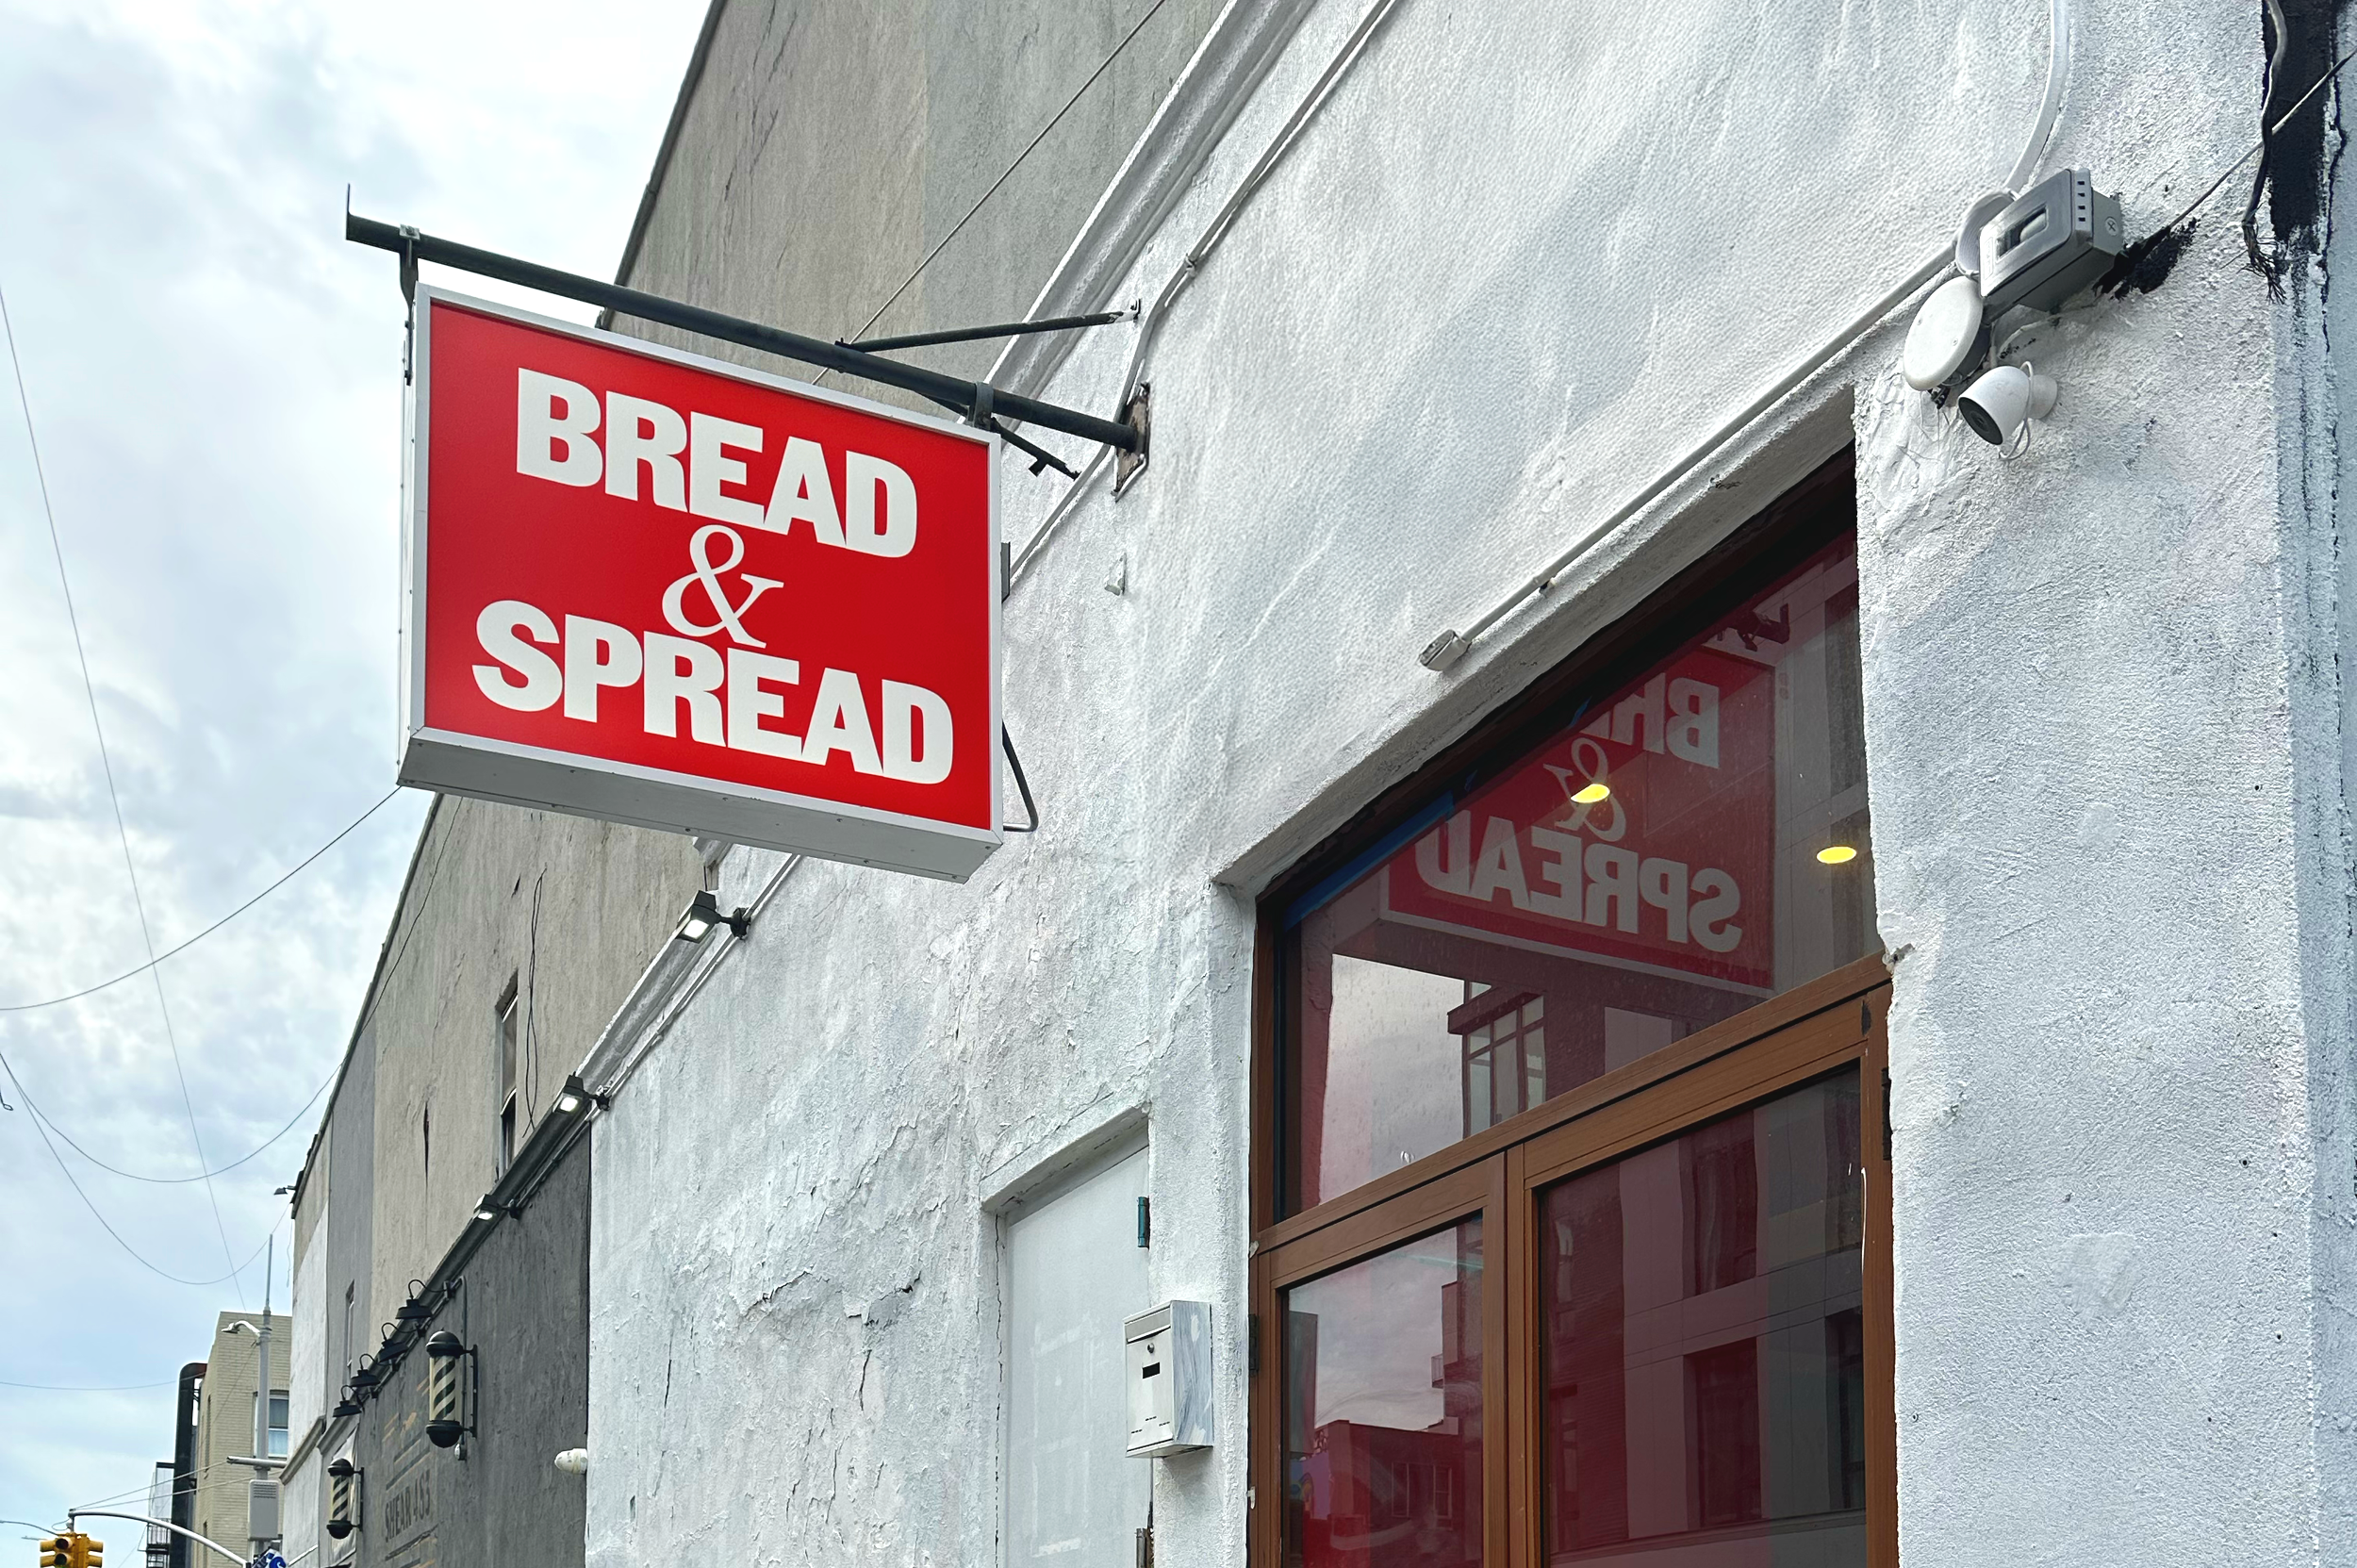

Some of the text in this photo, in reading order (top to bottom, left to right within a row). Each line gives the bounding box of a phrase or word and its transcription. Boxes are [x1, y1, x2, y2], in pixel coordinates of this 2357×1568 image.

[517, 367, 917, 558] BREAD
[662, 524, 784, 649] &
[471, 600, 954, 785] SPREAD
